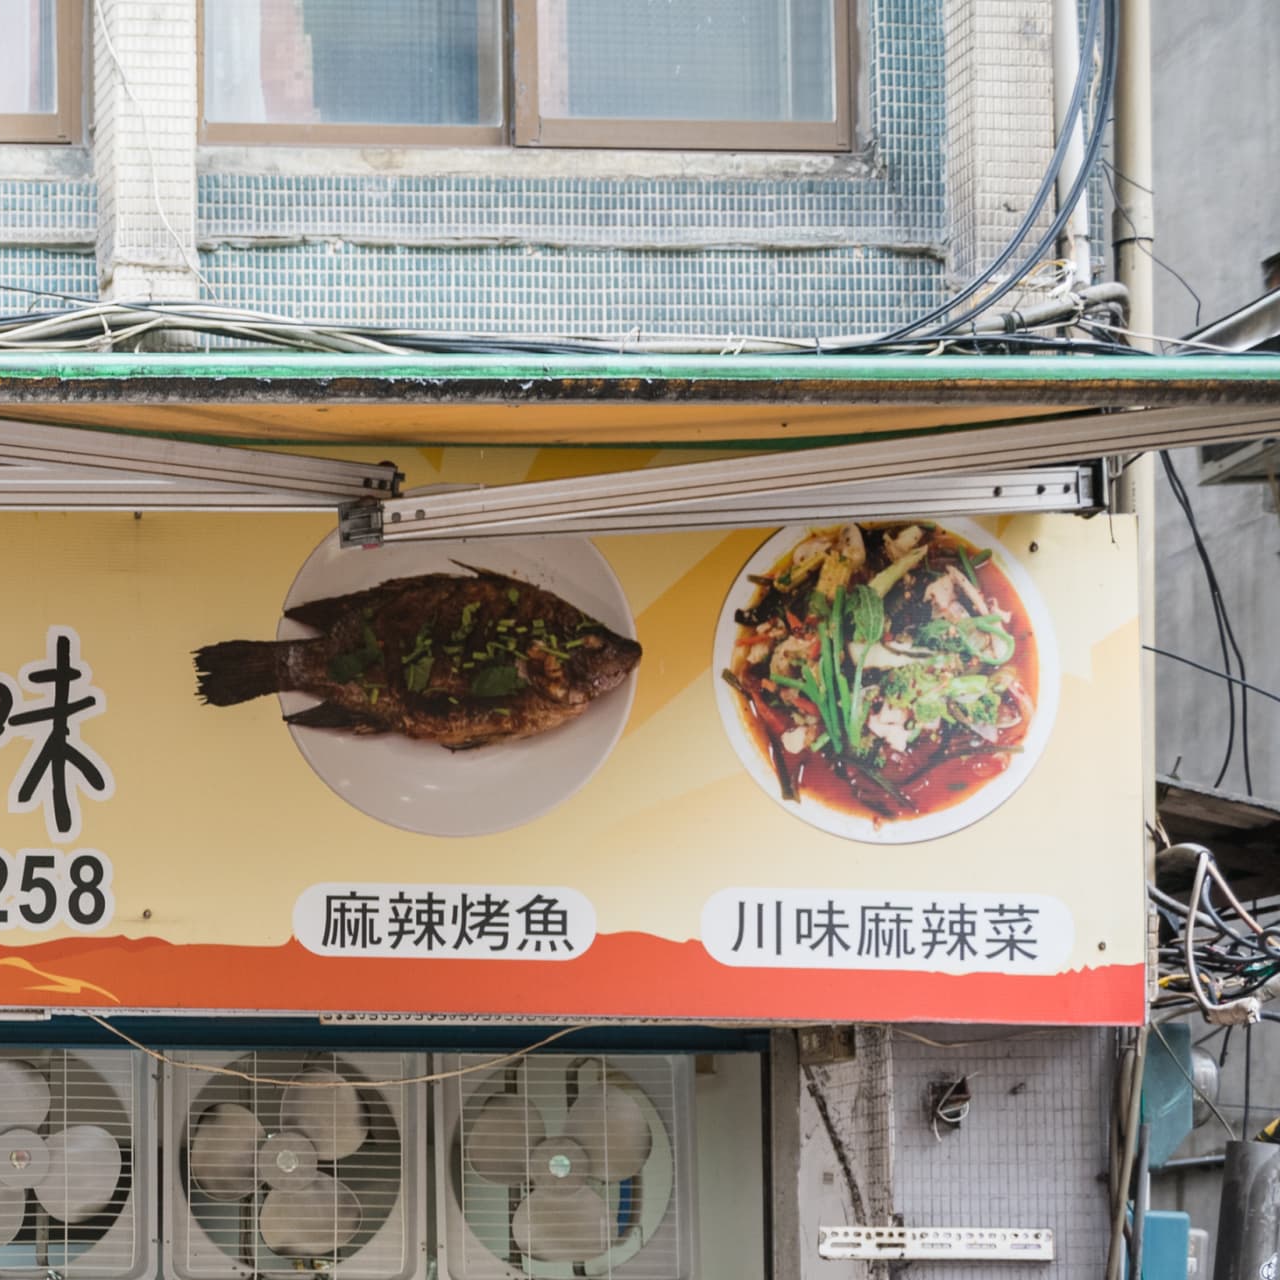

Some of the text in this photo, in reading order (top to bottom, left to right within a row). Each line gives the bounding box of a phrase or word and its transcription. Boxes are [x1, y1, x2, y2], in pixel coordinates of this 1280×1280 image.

[321, 892, 576, 952] 麻辣烤魚
[730, 898, 1041, 962] 川味麻辣菜
